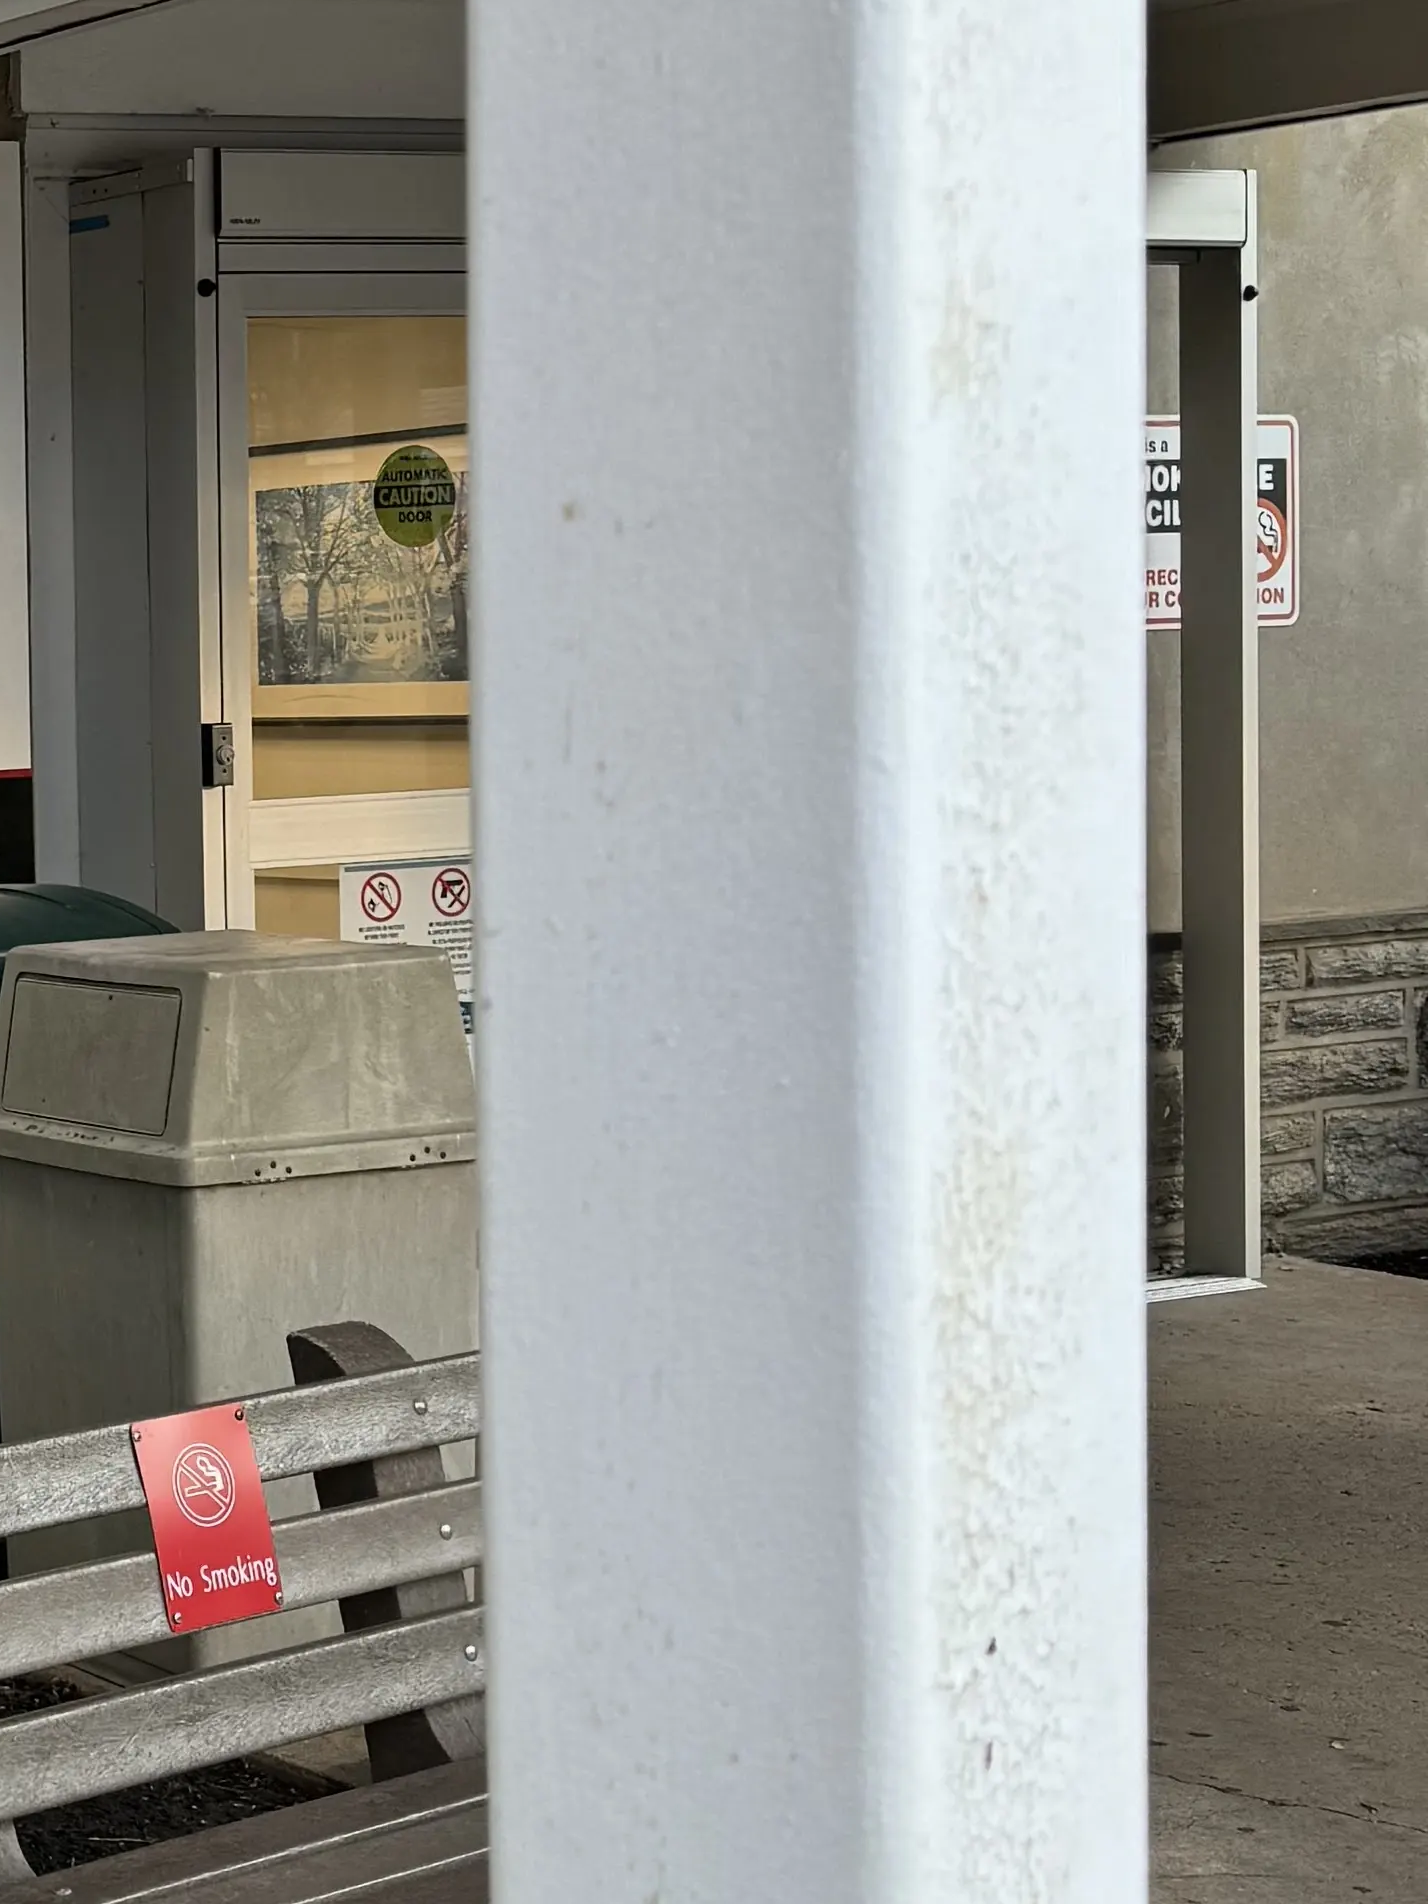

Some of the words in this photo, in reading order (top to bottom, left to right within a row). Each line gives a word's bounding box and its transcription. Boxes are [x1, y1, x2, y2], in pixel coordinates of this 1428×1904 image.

[1160, 440, 1169, 453] a
[382, 468, 447, 483] AUTOMATIC
[378, 485, 451, 506] CAUTION
[398, 510, 433, 523] DOOR
[166, 1571, 193, 1601] No
[200, 1554, 277, 1594] Smoking
